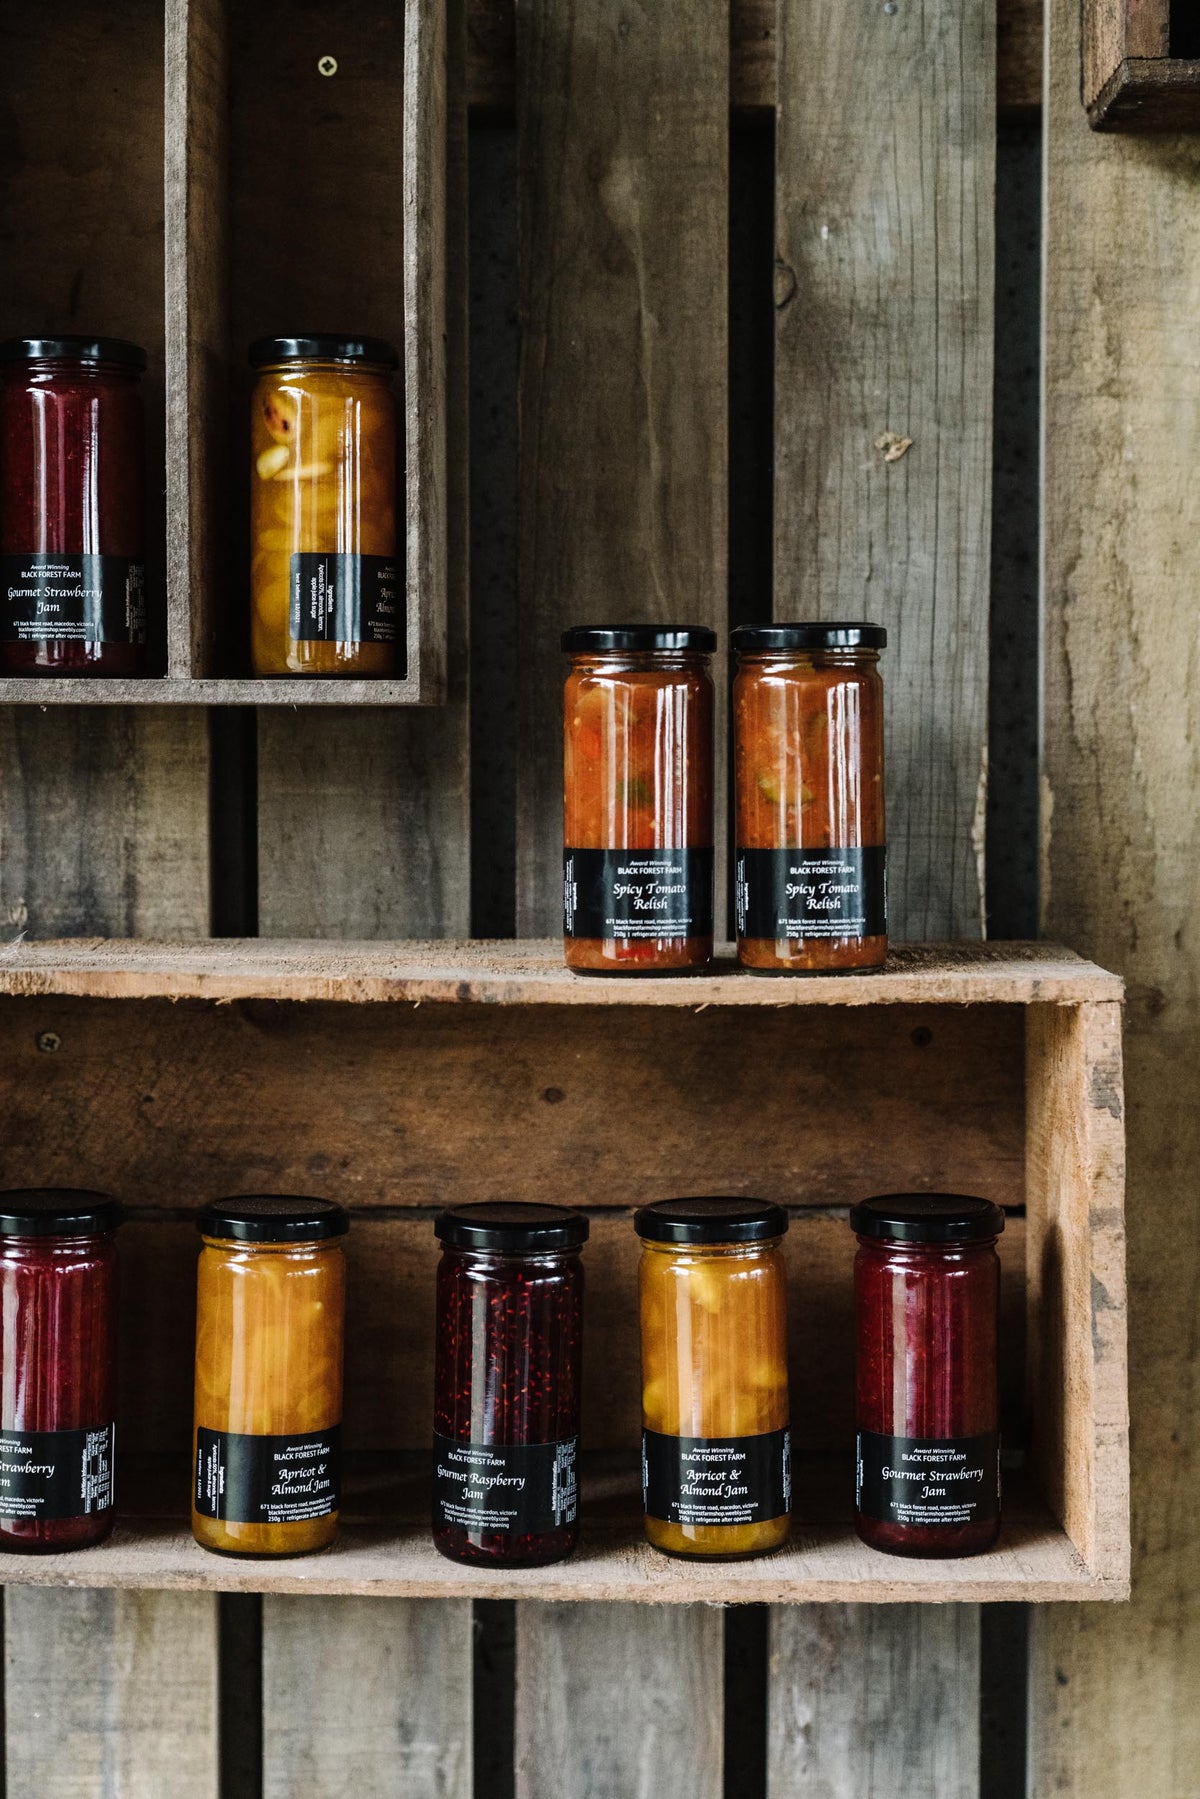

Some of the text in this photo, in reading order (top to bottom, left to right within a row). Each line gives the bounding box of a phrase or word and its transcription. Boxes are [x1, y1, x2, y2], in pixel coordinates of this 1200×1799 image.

[7, 585, 102, 601] Gourmet Strawberry
[37, 602, 60, 614] Jam
[613, 881, 686, 899] Spicy Tomato
[785, 881, 859, 899] Spicy Tomato
[633, 896, 668, 910] Relish
[806, 896, 841, 909] Relish
[274, 1447, 330, 1461] BLACK FOREST FARM
[448, 1452, 463, 1462] BLACK
[464, 1456, 486, 1465] FOREST
[457, 1448, 493, 1458] Award Winning
[923, 1454, 948, 1462] FOREST
[279, 1464, 327, 1483] Apricot &
[437, 1464, 525, 1490] Gourmet Raspberry
[686, 1469, 742, 1485] Apricot &
[882, 1467, 984, 1482] Gourmet Strawberry
[272, 1479, 330, 1495] Almond Jam
[461, 1488, 483, 1500] Jam
[680, 1483, 748, 1498] Almond Jam
[921, 1486, 946, 1498] Jam
